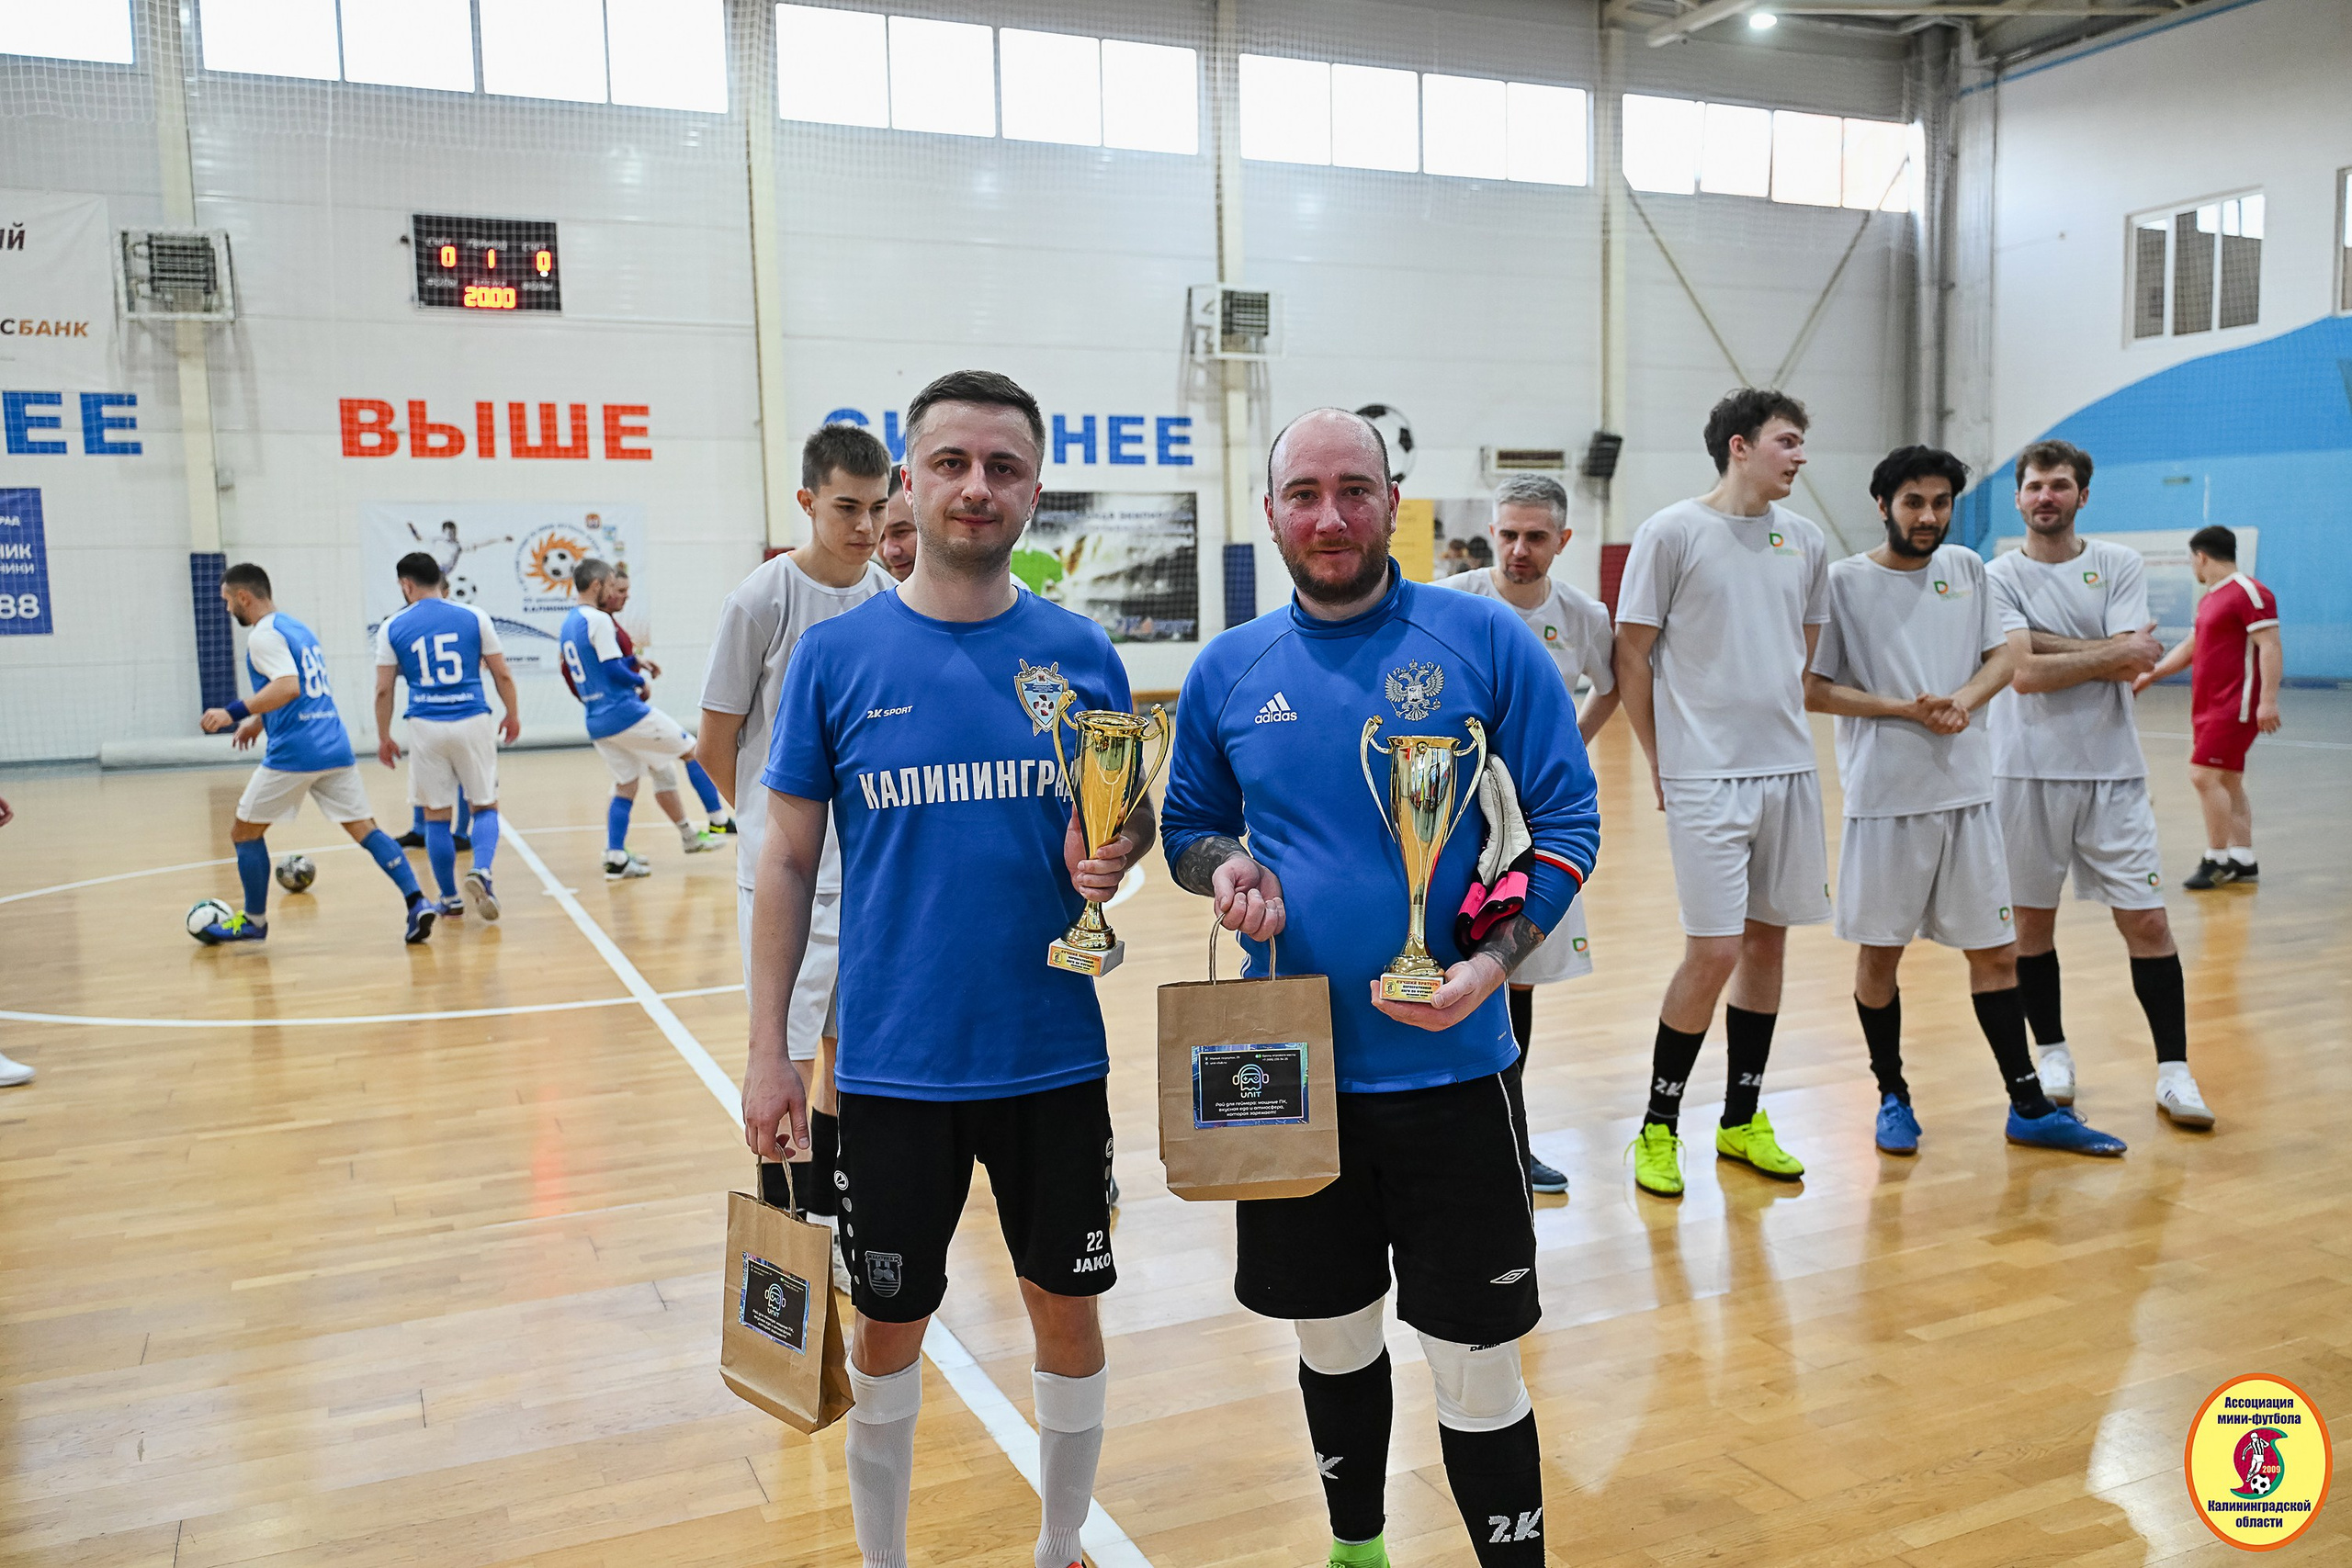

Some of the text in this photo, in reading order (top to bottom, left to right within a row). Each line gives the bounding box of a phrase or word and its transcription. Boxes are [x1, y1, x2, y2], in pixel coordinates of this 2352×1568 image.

[441, 245, 457, 267] 0
[2, 390, 142, 455] ЕЕ
[339, 398, 652, 460] ВЫШЕ
[0, 543, 32, 559] ИК
[411, 632, 463, 687] 15
[563, 639, 586, 683] 9
[884, 705, 913, 716] SPORT
[1254, 708, 1297, 724] adidas
[1086, 1230, 1103, 1252] 22
[1073, 1252, 1111, 1273] JAKO
